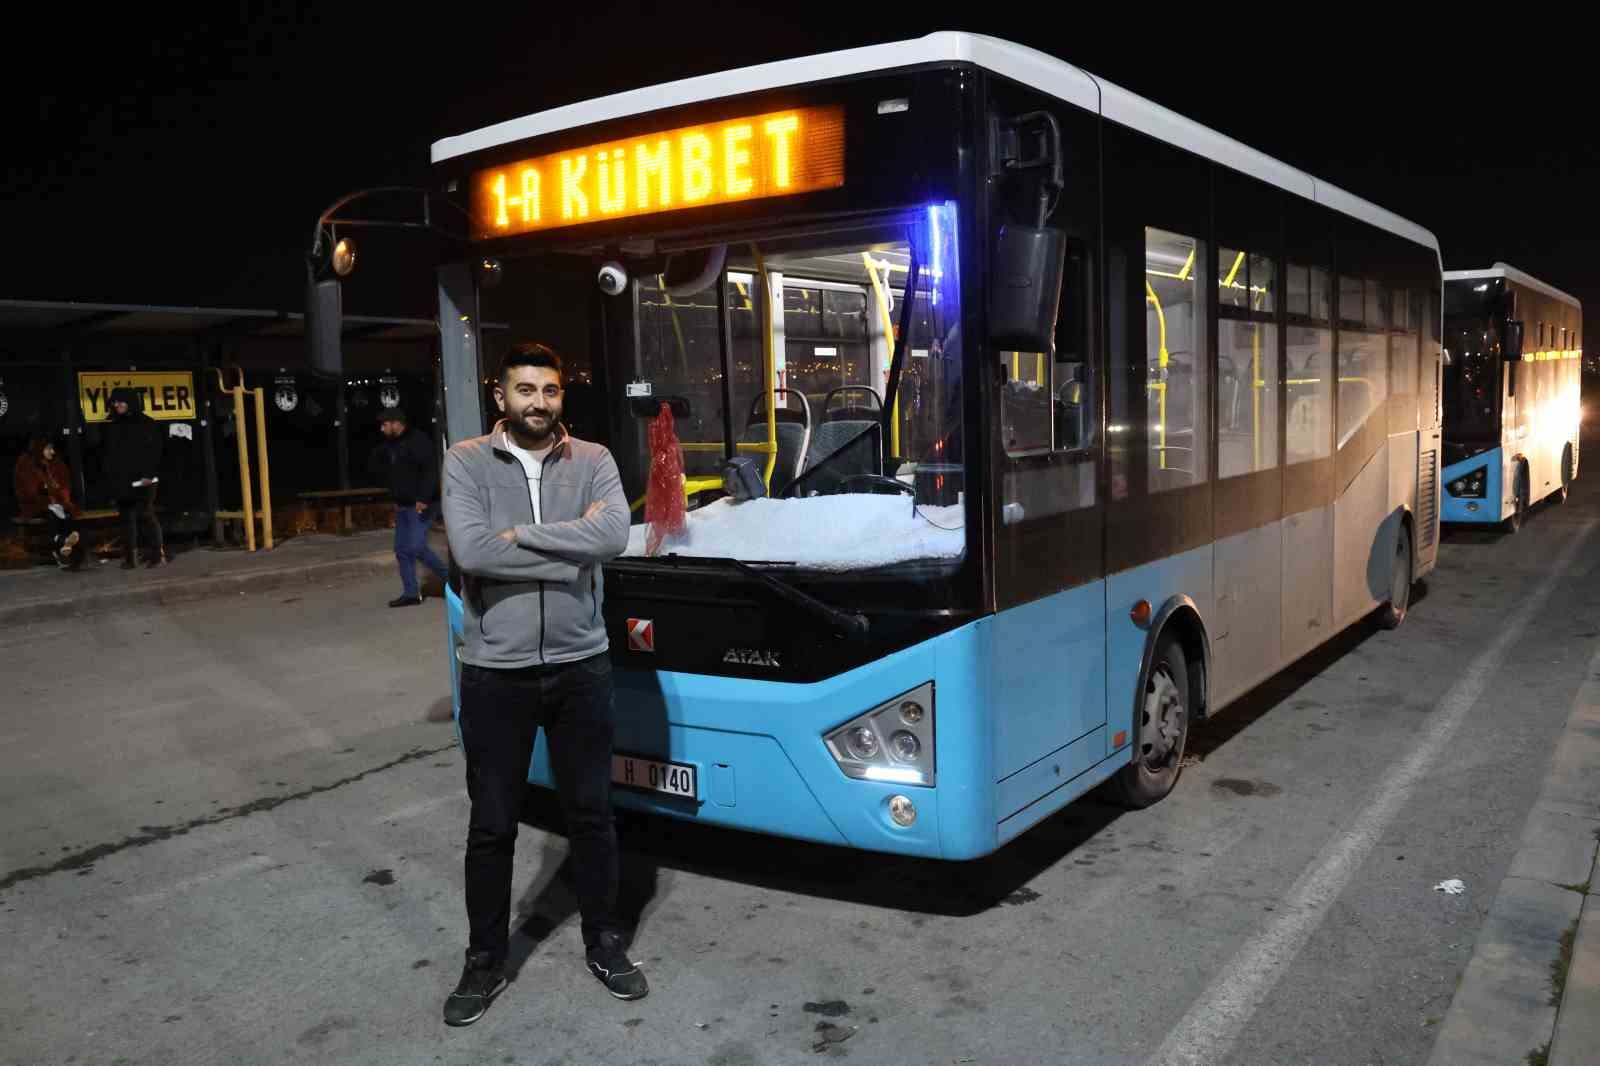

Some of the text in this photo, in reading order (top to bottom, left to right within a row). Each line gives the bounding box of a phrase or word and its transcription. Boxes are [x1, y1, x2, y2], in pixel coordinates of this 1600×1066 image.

[491, 115, 800, 227] 1-A KÜMBET
[649, 764, 690, 793] 0140
